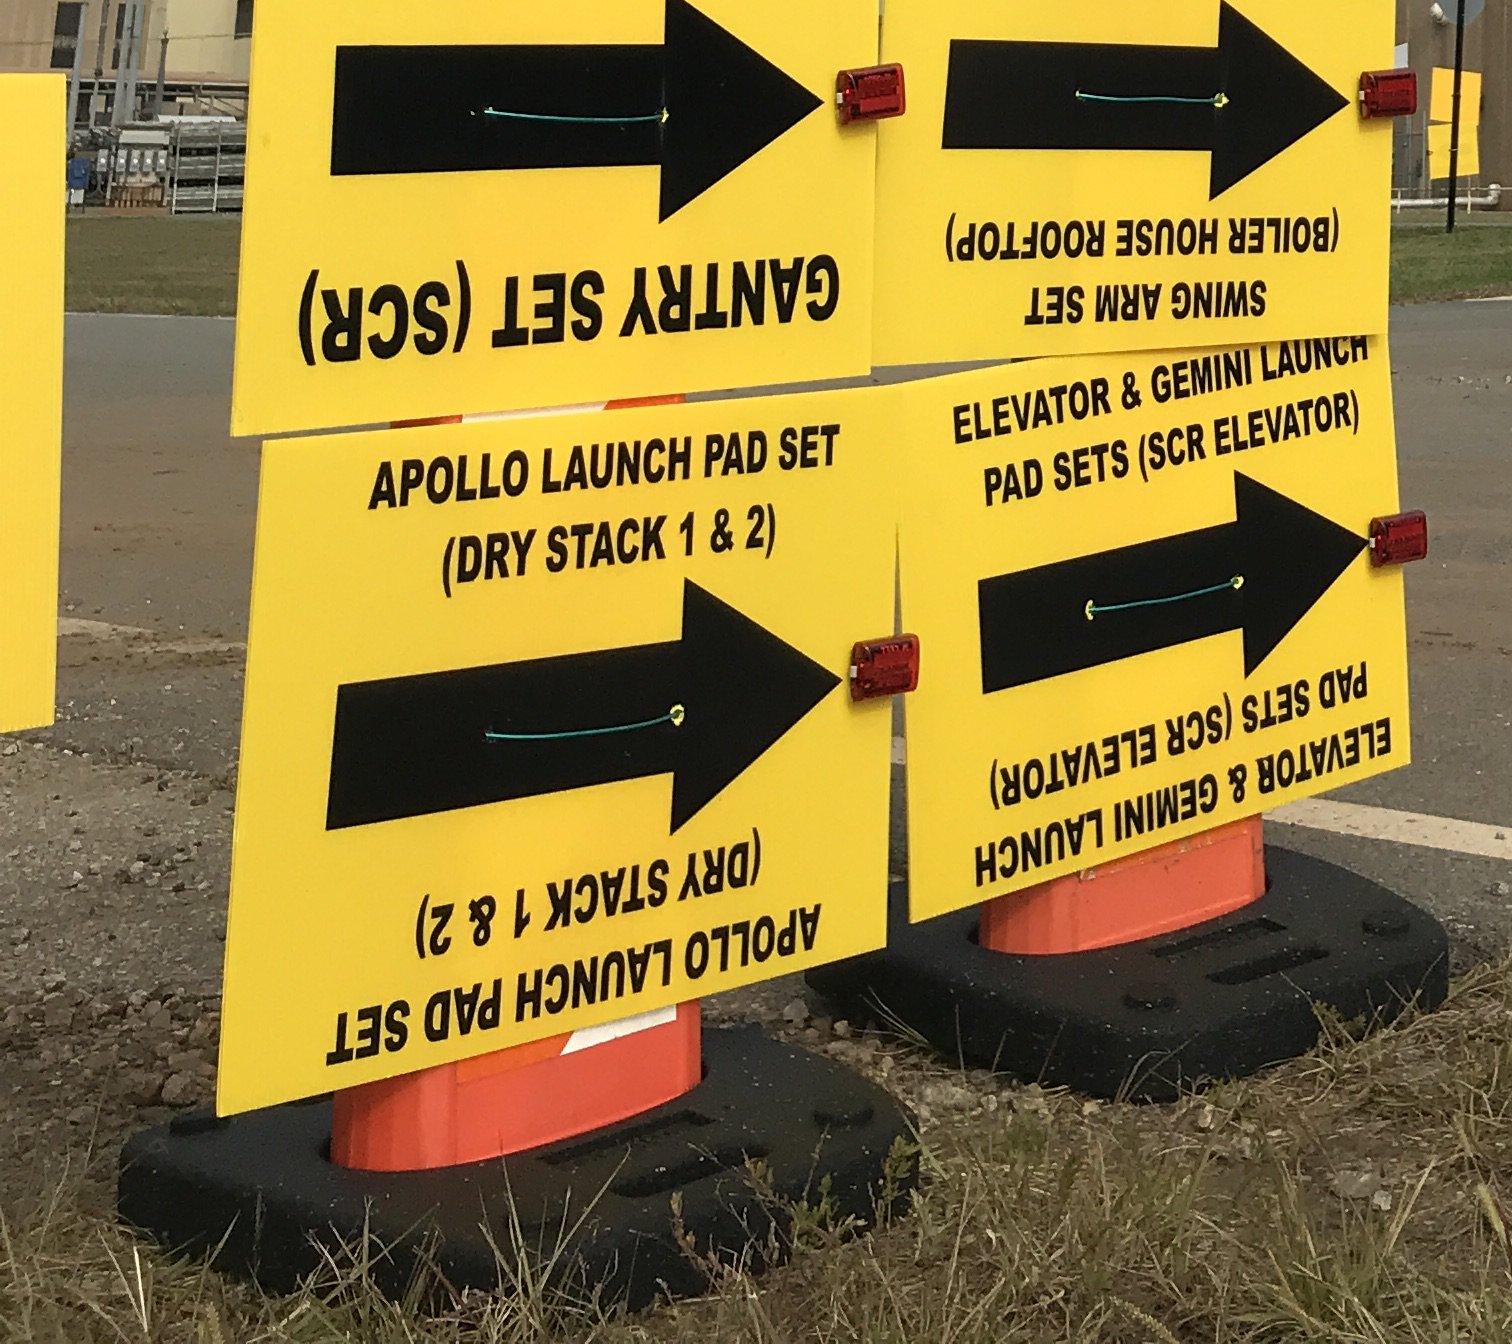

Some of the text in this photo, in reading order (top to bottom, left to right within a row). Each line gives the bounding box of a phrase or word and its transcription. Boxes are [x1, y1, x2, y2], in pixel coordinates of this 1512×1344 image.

[945, 207, 1339, 262] (BOILER HOUSE ROOFTOP)
[298, 254, 840, 367] GANTRY SET (SCR)
[1024, 280, 1267, 326] SWING ARM SET
[953, 335, 1368, 445] ELEVATOR & GEMINI LAUNCH
[367, 424, 841, 510] APOLLO LAUNCH PAD SET
[984, 389, 1359, 507] PAD SETS (SCR ELEVATOR)
[442, 503, 776, 598] (DRY STACK 1 & 2)
[990, 661, 1368, 810] PAD SETS (SCR ELEVATOR)
[975, 717, 1391, 888] ELEVATOR & GEMINI LAUNCH
[415, 827, 761, 960] (DRY STACK 1 & 2)
[325, 903, 821, 1067] APOLLO LAUNCH PAD SET
